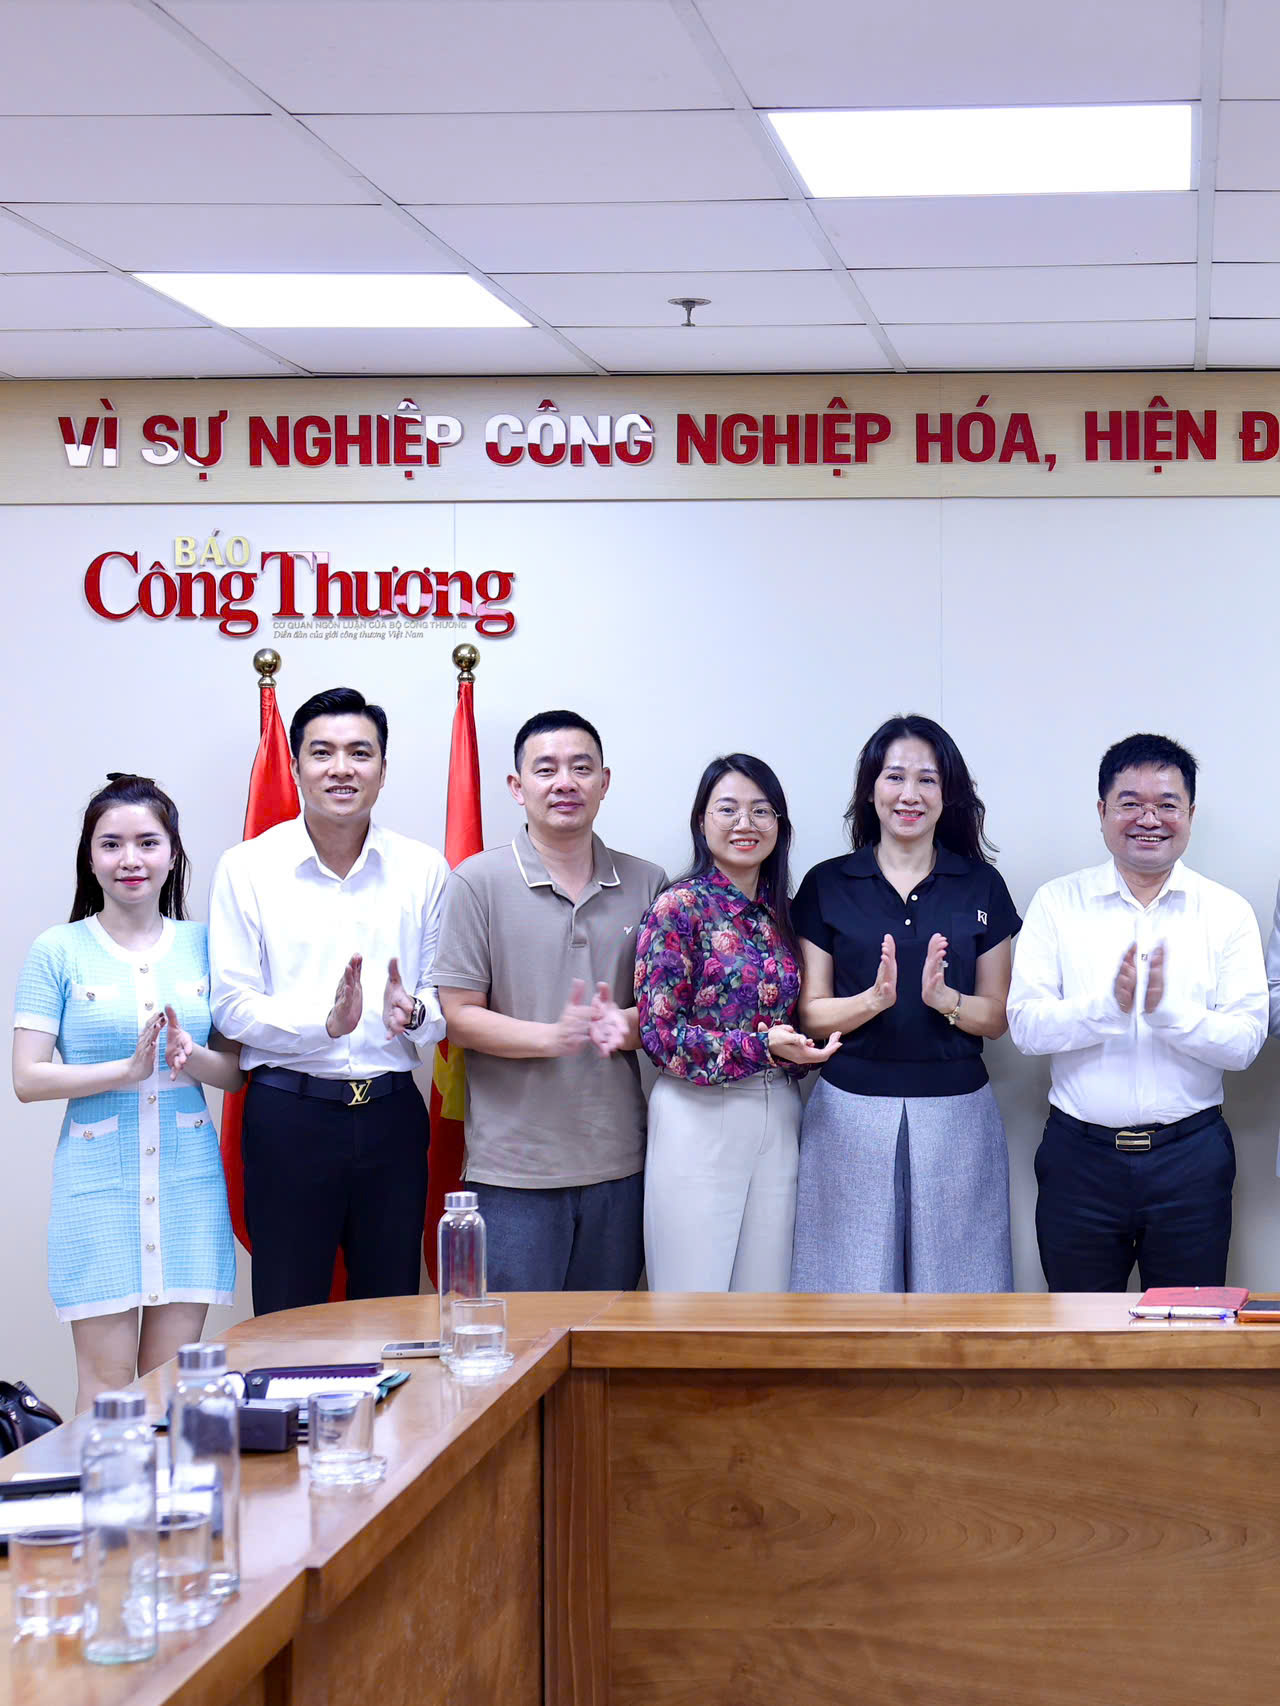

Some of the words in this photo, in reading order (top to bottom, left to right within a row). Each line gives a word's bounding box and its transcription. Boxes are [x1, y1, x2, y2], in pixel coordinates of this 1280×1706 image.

[58, 398, 120, 468] VÌ
[140, 409, 229, 481] SỰ
[248, 397, 464, 480] NGHIỆP
[484, 398, 656, 467] CÔNG
[675, 395, 892, 478] NGHIỆP
[915, 393, 1057, 472] HÓA,
[1084, 394, 1218, 474] HIỆN
[173, 527, 250, 567] BÁO
[83, 550, 260, 638] Công
[260, 551, 517, 638] Thương
[287, 621, 313, 629] QUAN
[404, 631, 424, 639] Nam
